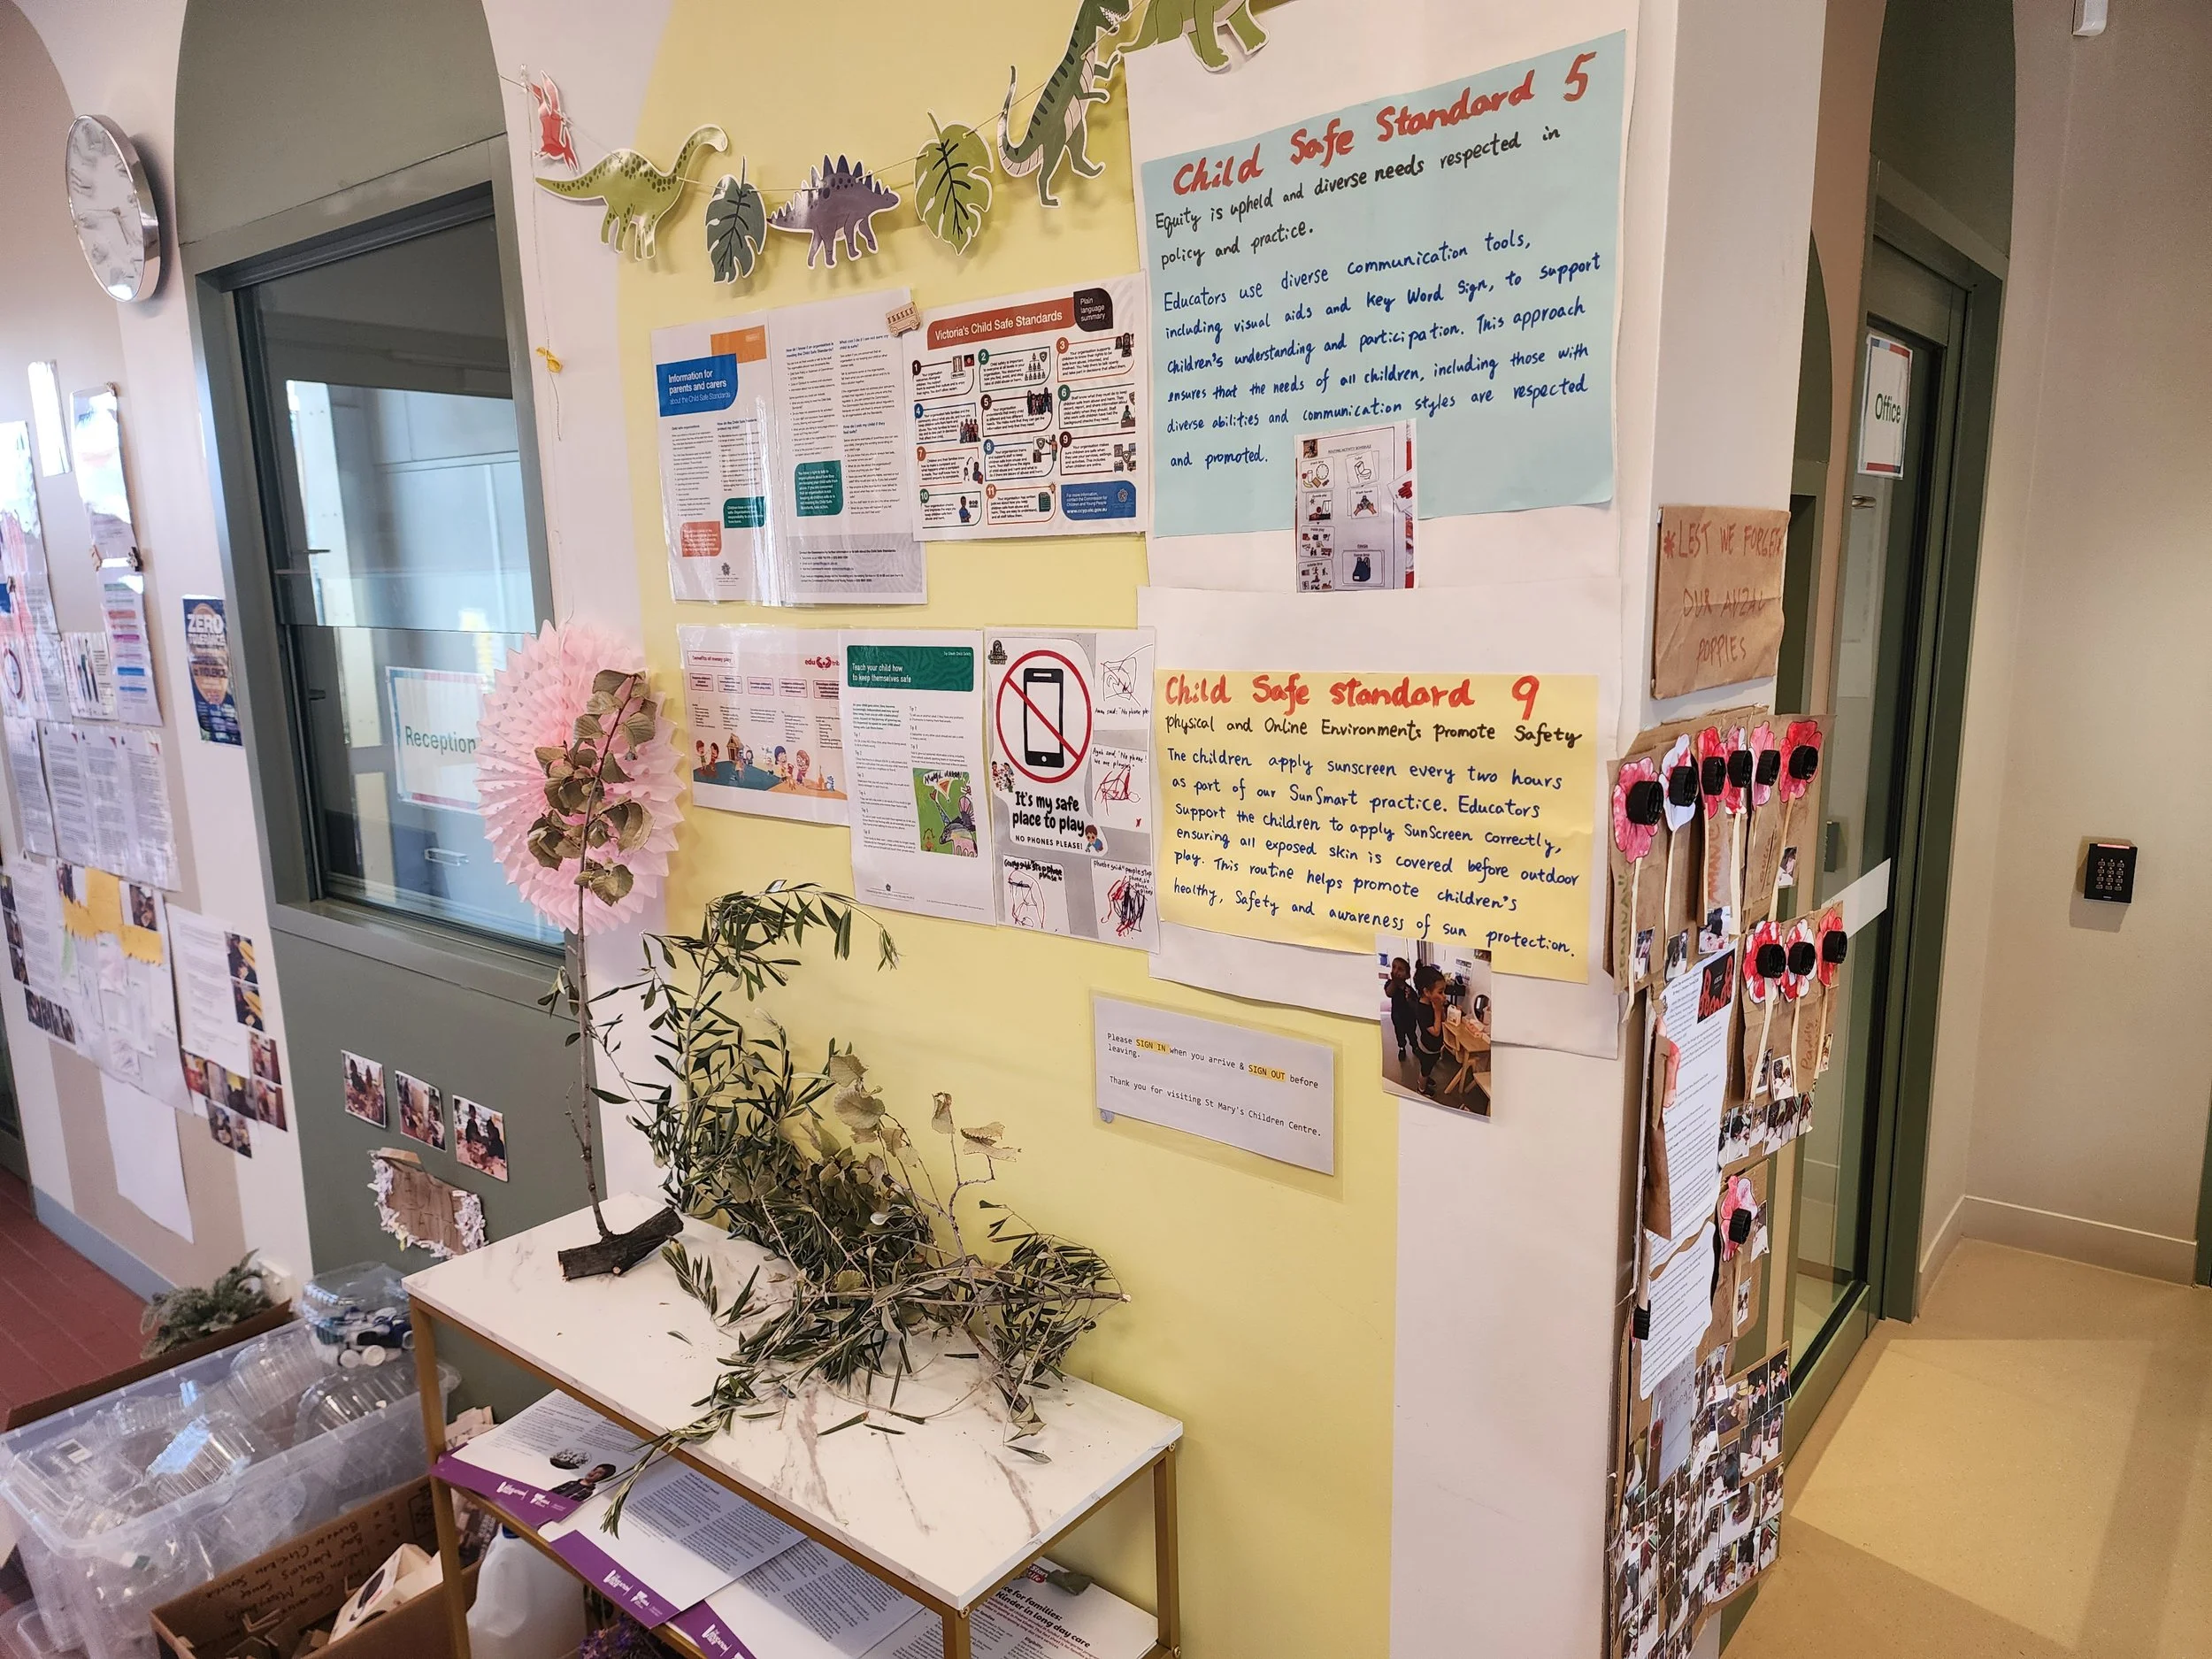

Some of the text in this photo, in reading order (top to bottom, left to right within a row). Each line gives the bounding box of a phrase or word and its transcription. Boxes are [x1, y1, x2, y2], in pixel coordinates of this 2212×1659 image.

[1173, 51, 1597, 196] Child Safe Standard 5
[1156, 126, 1560, 238] Equity is upheld and diverse needs respected in
[1161, 221, 1314, 270] policy and practice.
[1164, 229, 1530, 311] Educators use diverse communication tools,
[1079, 304, 1105, 314] language
[1165, 319, 1223, 344] including
[1234, 313, 1271, 332] visual
[1285, 303, 1312, 322] aids
[1325, 296, 1351, 315] and
[1408, 283, 1444, 304] Word
[1458, 280, 1494, 302] Sign,
[1505, 271, 1522, 286] to
[1540, 252, 1600, 284] support
[935, 311, 1063, 341] Victoria's Child Safe Standards
[1080, 313, 1106, 322] summary
[1234, 340, 1316, 365] understanding
[1324, 333, 1347, 351] and
[1360, 323, 1464, 352] participation.
[1477, 314, 1504, 334] This
[1513, 296, 1586, 331] approach
[669, 369, 713, 383] Information for
[669, 380, 726, 396] parents and carers
[1875, 393, 1901, 423] Office
[1171, 444, 1268, 470] and promoted.
[1678, 520, 1711, 557] LEST
[1720, 523, 1736, 556] WE
[1683, 588, 1713, 618] OUR
[188, 614, 224, 634] ZERO
[1696, 634, 1747, 668] POPPIES
[858, 674, 871, 683] keep
[1166, 673, 1232, 706] Child
[1253, 673, 1310, 716] Safe
[1512, 675, 1540, 720] 9
[405, 726, 476, 755] Reception
[1226, 718, 1253, 733] and
[1264, 718, 1308, 735] Online
[1322, 718, 1421, 741] Environments
[1514, 722, 1582, 749] Safety
[1167, 748, 1562, 789] The children apply sunscreen every two hours
[1015, 791, 1079, 814] It's my safe
[1172, 778, 1186, 787] as
[1194, 779, 1221, 795] part
[1233, 778, 1246, 801] of
[1369, 794, 1448, 813] practice.
[1458, 795, 1540, 818] Educators
[1012, 810, 1085, 837] place to play
[1236, 810, 1255, 823] the
[1263, 812, 1320, 831] children
[1329, 817, 1343, 832] to
[1350, 822, 1394, 841] apply
[1027, 836, 1054, 846] PHONES
[1056, 841, 1083, 849] PLEASE!
[1174, 849, 1517, 911] play. This routine helps promote children's
[1174, 877, 1575, 956] healthy, Safety and awareness of sun protection.
[1108, 1045, 1140, 1058] leaving.
[1108, 1033, 1132, 1044] Please
[1136, 1040, 1153, 1048] SIGN
[1157, 1043, 1165, 1052] IN
[1170, 1048, 1187, 1056] when
[1209, 1056, 1235, 1068] arrive
[1248, 1064, 1266, 1075] SIGN
[1271, 1071, 1285, 1079] OUT
[1290, 1075, 1317, 1088] before
[1110, 1076, 1129, 1087] Thank
[1167, 1090, 1201, 1106] visiting
[1218, 1102, 1244, 1115] Mary's
[1248, 1110, 1284, 1125] Children
[1289, 1122, 1321, 1135] Centre.
[995, 1592, 1091, 1647] Kinder in long day care
[1015, 1590, 1063, 1621] for families:
